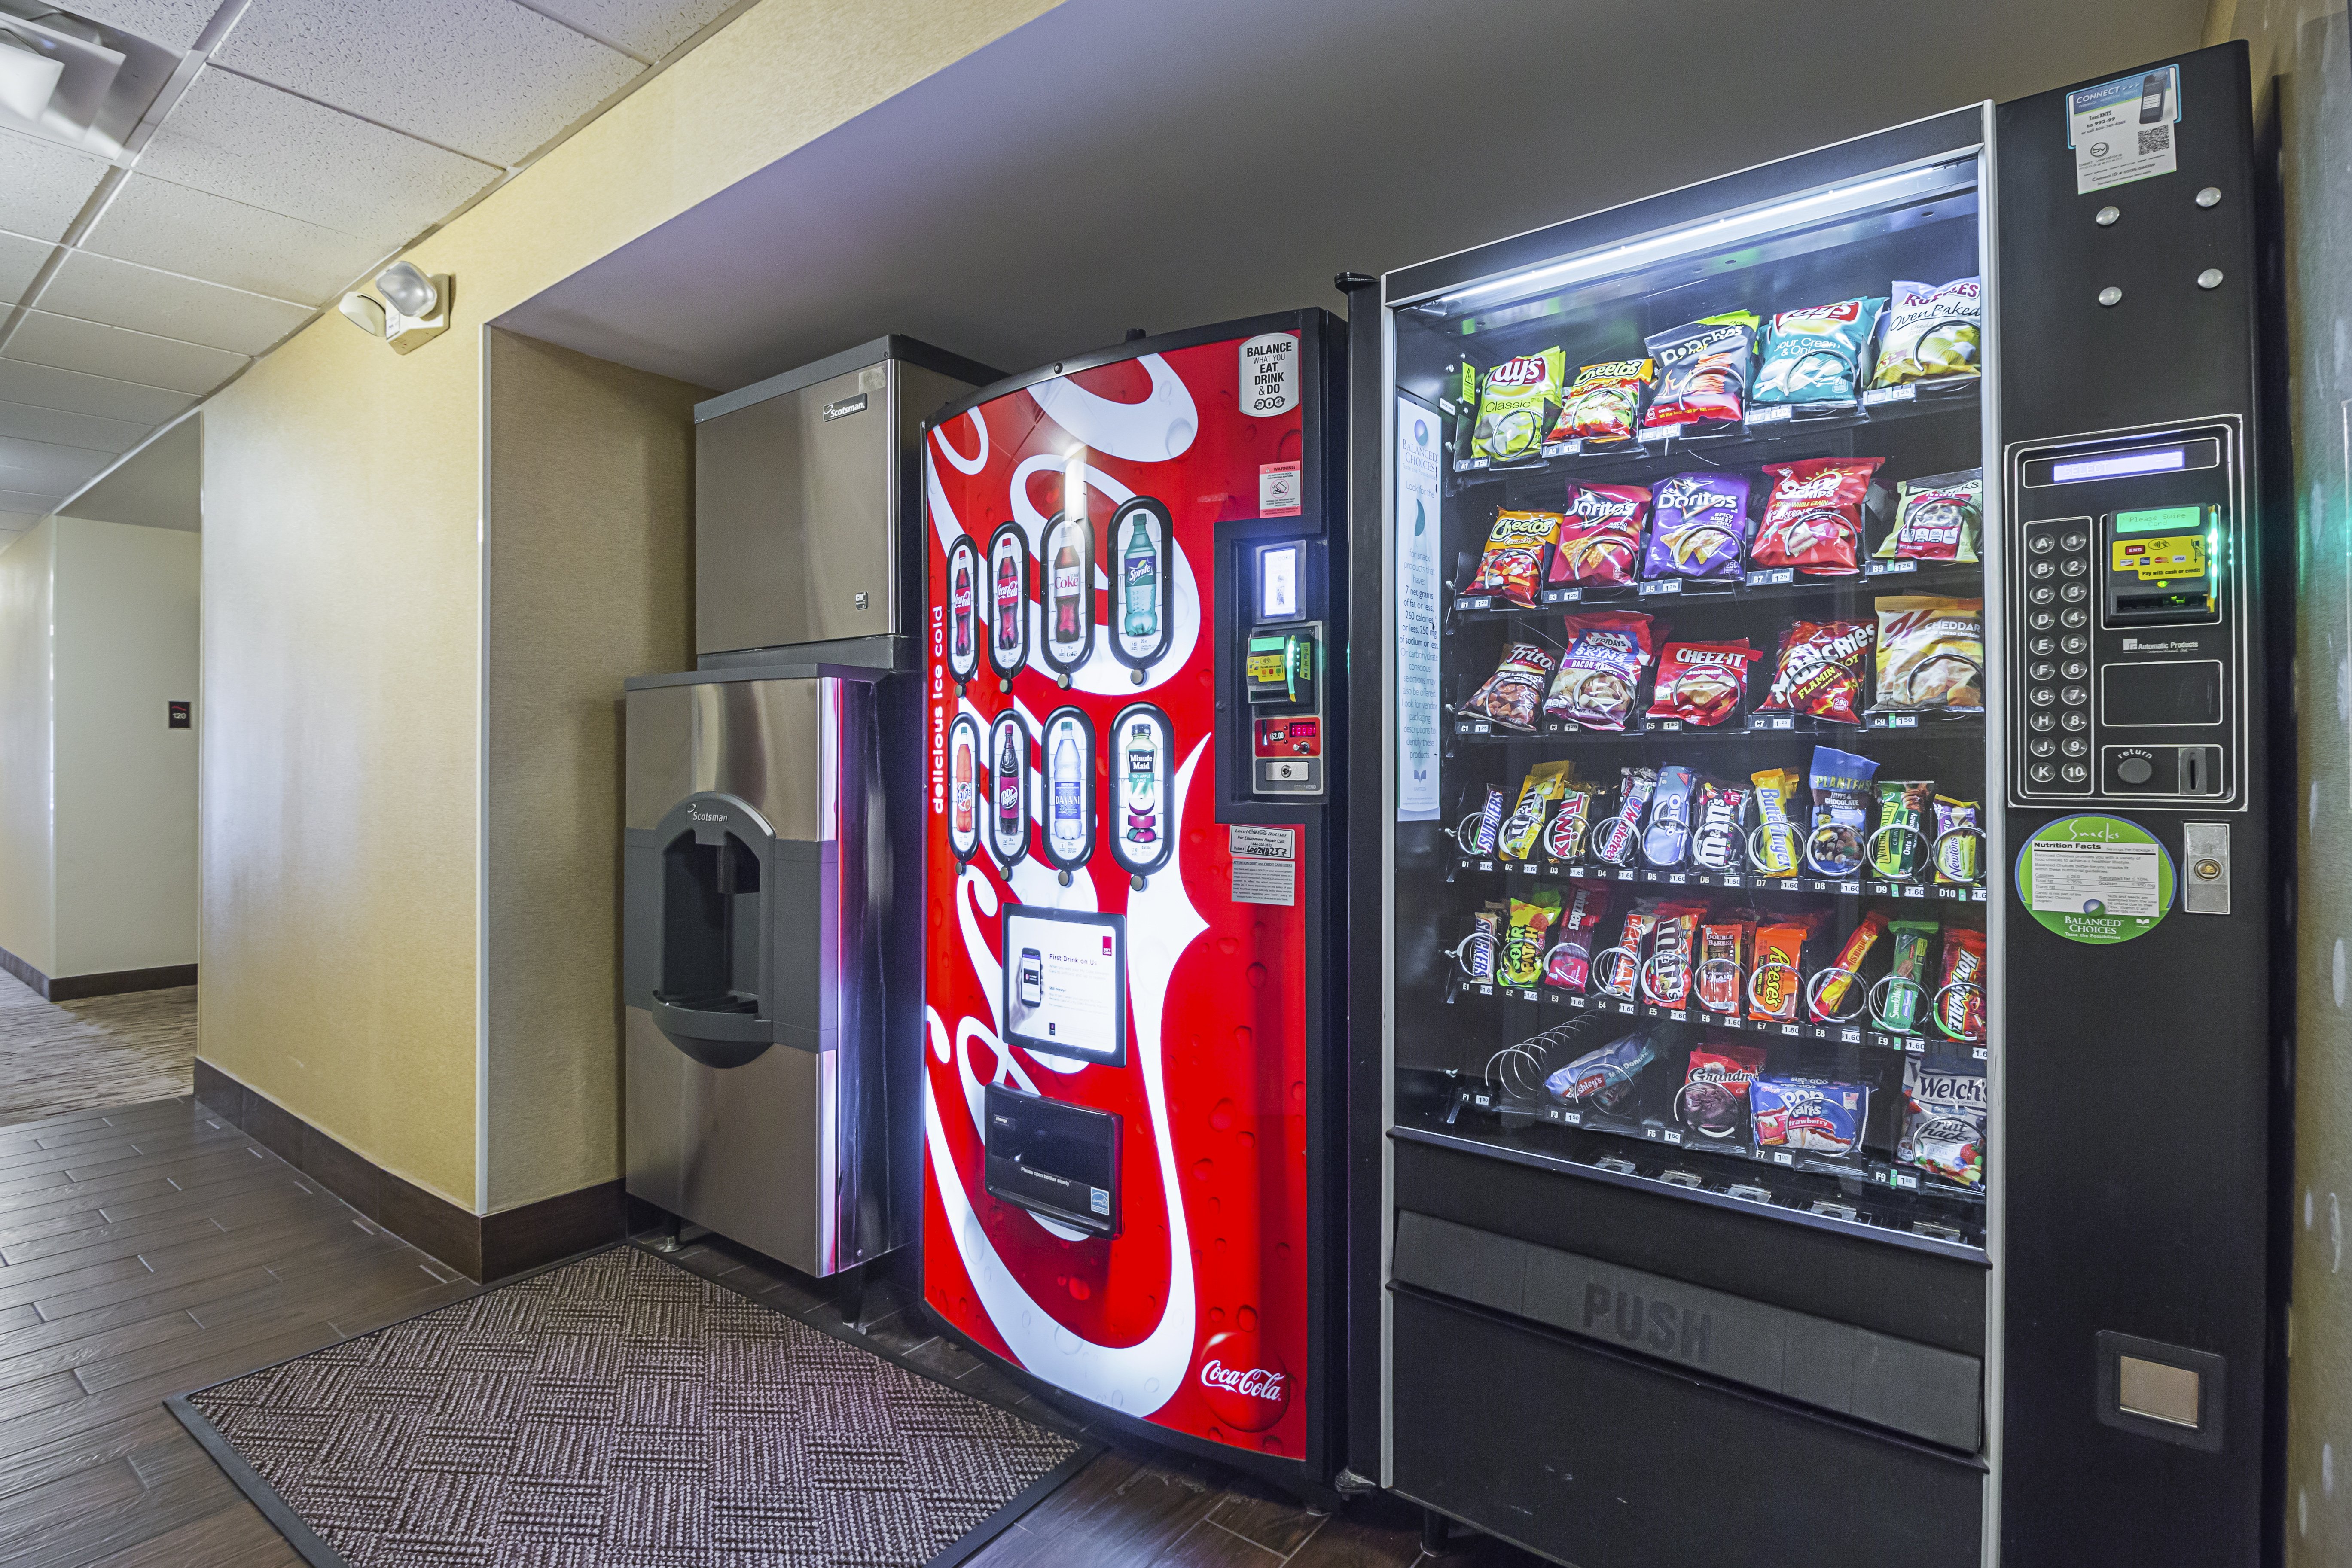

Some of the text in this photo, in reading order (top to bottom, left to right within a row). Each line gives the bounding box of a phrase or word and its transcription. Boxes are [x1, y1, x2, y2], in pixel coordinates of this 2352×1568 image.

[2076, 86, 2120, 104] CONNECT
[1891, 302, 1980, 331] Oven Baked
[1247, 341, 1292, 358] BALANCE
[1253, 353, 1285, 364] WHAT YOU
[1254, 372, 1284, 386] DRINK
[1258, 384, 1280, 396] & DO
[830, 402, 865, 418] Scotsman
[1485, 400, 1531, 413] Classic
[1402, 438, 1437, 462] BALANCED
[1405, 451, 1435, 472] CHOICES
[2064, 463, 2108, 477] SELECT
[1406, 483, 1418, 493] Look
[1658, 494, 1736, 510] Doritos
[1710, 516, 1733, 524] SWEET
[1490, 517, 1556, 542] Cheetos
[1504, 536, 1534, 545] Crunchy
[2038, 539, 2047, 548] A
[2070, 536, 2077, 545] 1
[1873, 565, 1883, 573] B9
[2038, 564, 2047, 573] B
[2070, 561, 2078, 570] 2
[1129, 563, 1152, 582] Sprite
[1054, 575, 1079, 590] Coke
[1754, 575, 1763, 584] B7
[2038, 589, 2048, 598] C
[2070, 587, 2079, 596] 3
[1405, 610, 1434, 624] 260 calories
[2038, 615, 2049, 624] D
[2070, 613, 2079, 622] 4
[1925, 621, 1980, 632] CHEDDAR
[933, 606, 942, 658] cold
[2039, 640, 2048, 649] E
[2071, 639, 2079, 648] 5
[1571, 659, 1594, 669] BACON
[2071, 664, 2079, 673] 6
[2039, 665, 2048, 675] F
[933, 666, 942, 698] ice
[2038, 691, 2049, 700] G
[2071, 691, 2079, 700] 7
[1755, 719, 1765, 728] C7
[2039, 716, 2049, 725] H
[2071, 716, 2079, 725] 8
[2040, 742, 2047, 751] J
[2071, 741, 2079, 751] 9
[1130, 754, 1153, 763] Minute
[2118, 748, 2153, 759] return
[933, 706, 943, 813] delicious
[1132, 761, 1150, 770] Maid
[2039, 767, 2049, 776] K
[2068, 768, 2084, 776] 10
[1001, 792, 1017, 806] Pepper
[1056, 795, 1080, 806] DASANI
[1824, 798, 1860, 806] CHOCOLATE
[693, 811, 728, 822] Scotsman
[1478, 790, 1503, 853] SNICKERS
[1554, 794, 1584, 856] TWIX
[1763, 788, 1790, 869] Butterfinger
[2069, 819, 2119, 841] Snacks
[1949, 837, 1959, 877] Newtons
[1939, 889, 1955, 897] D10
[2065, 916, 2121, 926] BALANCED
[2069, 924, 2117, 934] CHOICES
[1063, 956, 1078, 964] Drink
[1766, 945, 1791, 1007] Reese's
[1878, 1037, 1888, 1046] E9
[1647, 1129, 1656, 1137] F5
[1756, 1150, 1766, 1159] F7
[1021, 1166, 1034, 1175] Please
[1043, 1174, 1057, 1183] bottles
[1057, 1178, 1070, 1187] slowly
[1876, 1172, 1887, 1182] F9
[1581, 1281, 1713, 1365] PUSH
[1201, 1360, 1286, 1401] Coca-Cola
